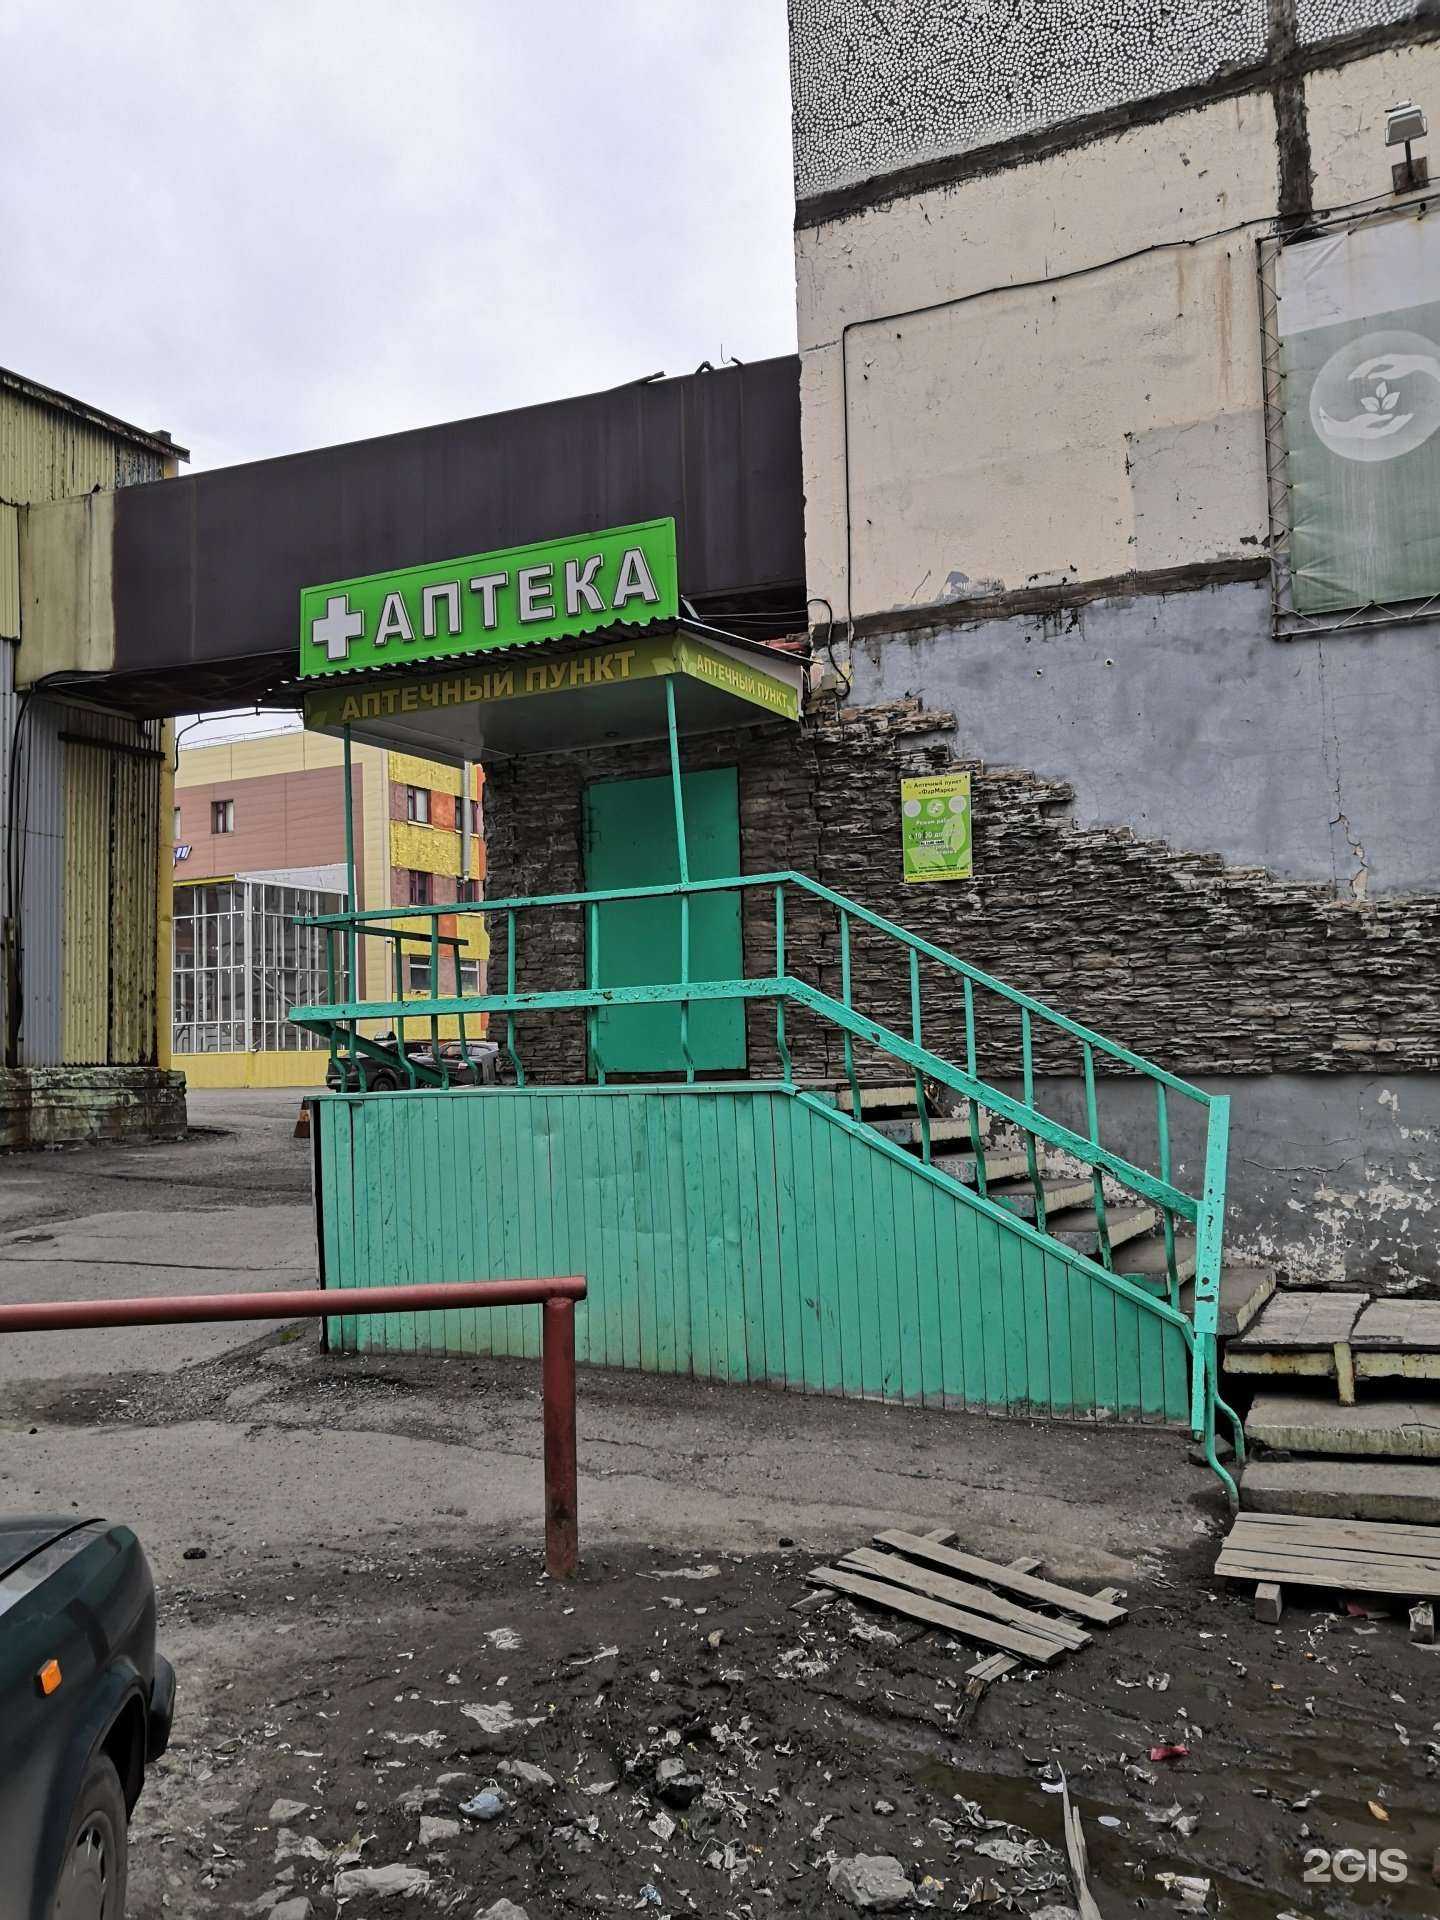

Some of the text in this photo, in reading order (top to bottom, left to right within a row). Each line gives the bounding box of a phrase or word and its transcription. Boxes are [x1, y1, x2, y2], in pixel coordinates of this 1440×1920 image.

[374, 546, 661, 647] АПТЕКА
[342, 650, 636, 721] АПТЕЧНЫЙ ПУНКТ
[696, 655, 788, 708] АПТЕЧНЫЙ ПУНКТ
